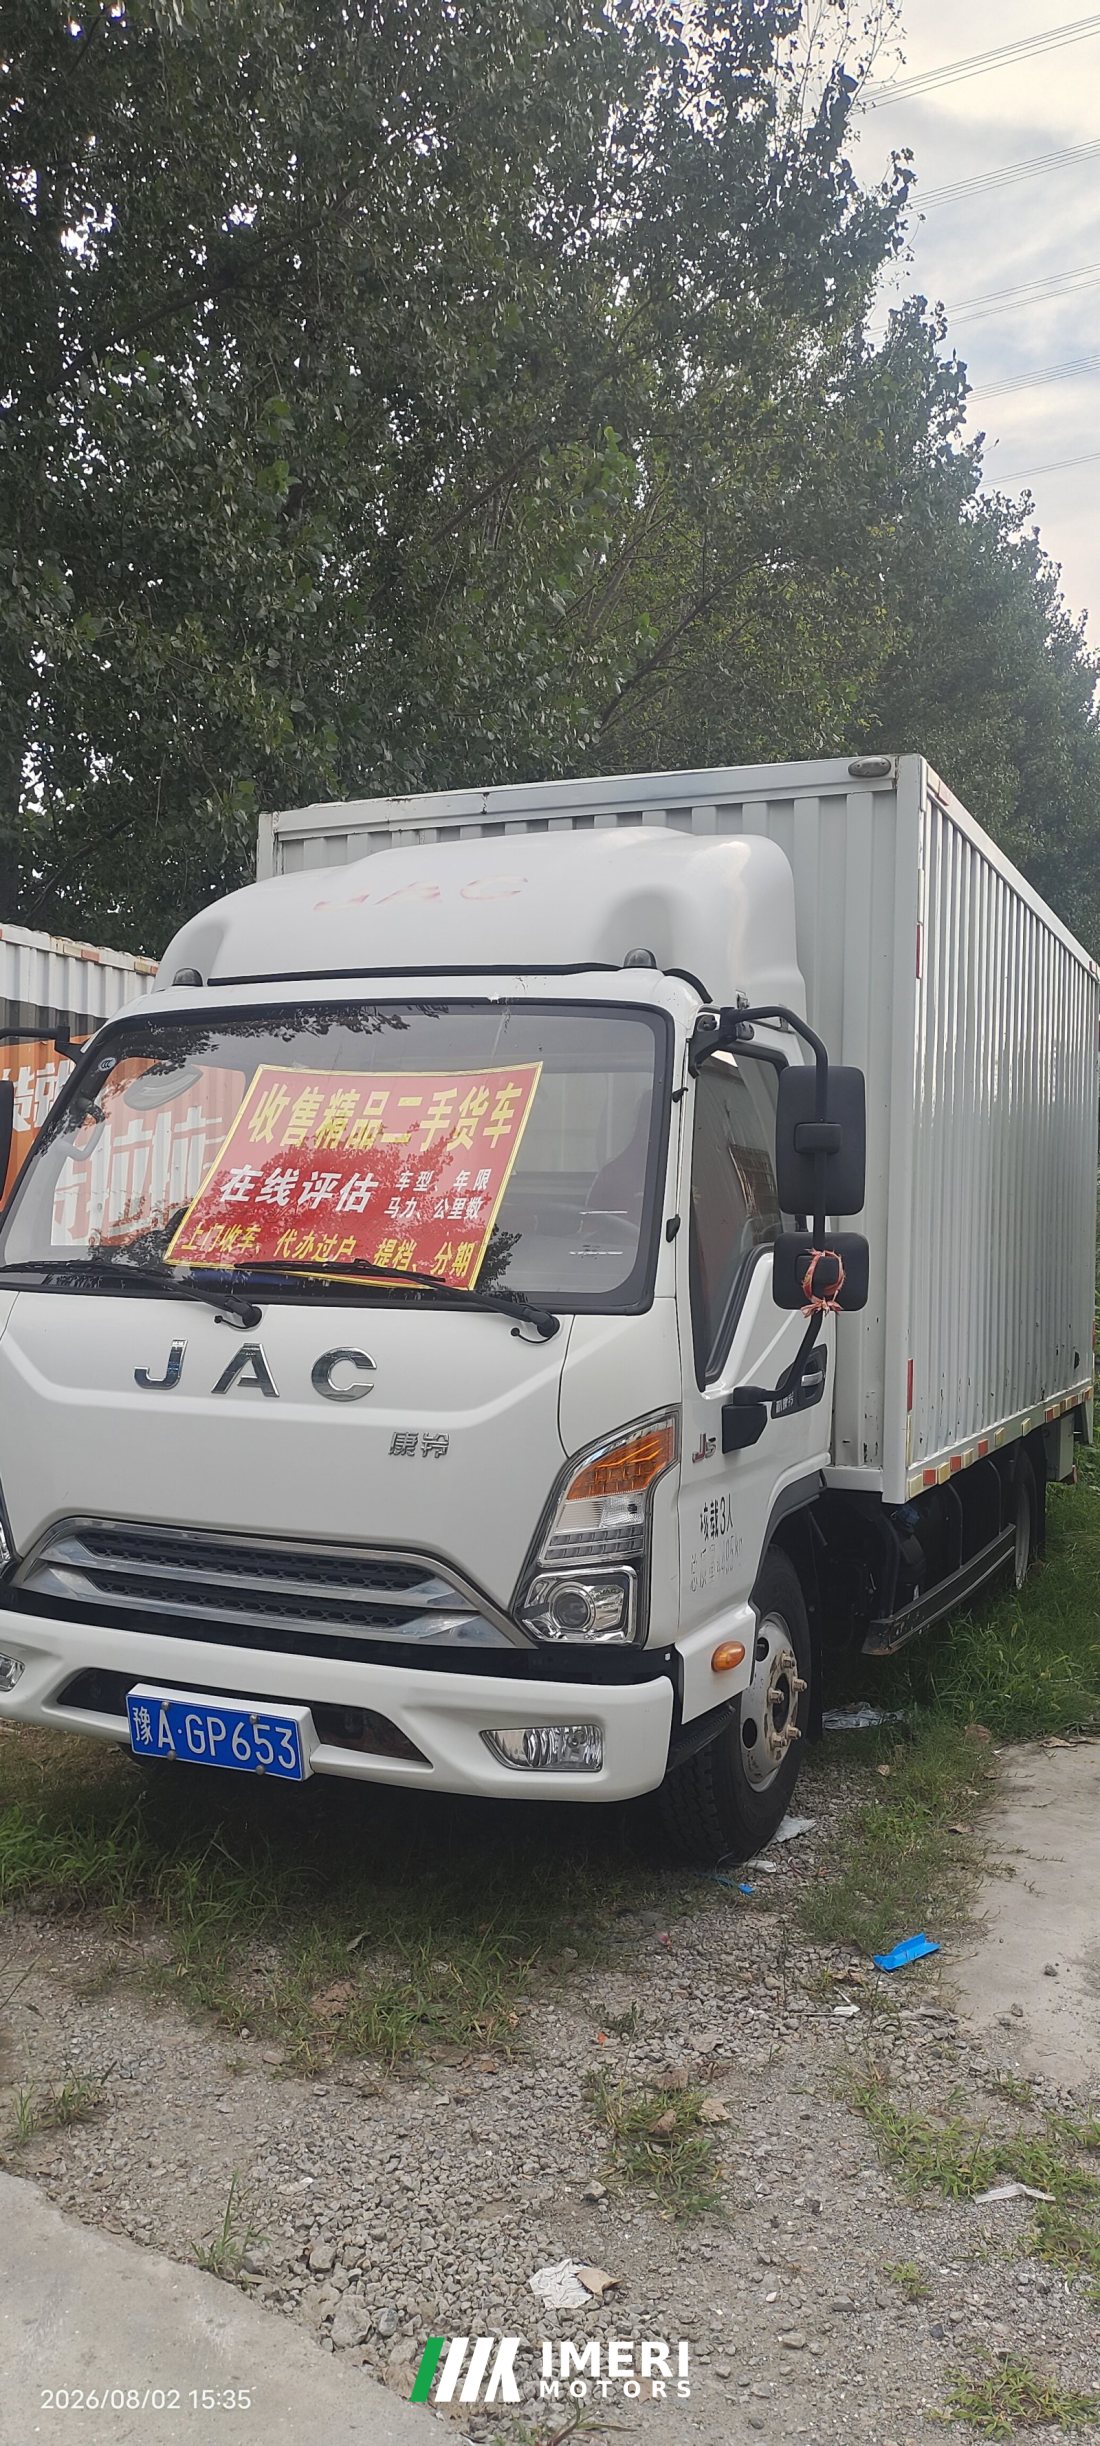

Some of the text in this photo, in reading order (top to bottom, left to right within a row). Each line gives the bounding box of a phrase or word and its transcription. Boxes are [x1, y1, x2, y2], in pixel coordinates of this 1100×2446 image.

[248, 1082, 523, 1152] 收售精品二手货车
[219, 1164, 380, 1213] 在线评估
[134, 1339, 378, 1402] JAC
[388, 1431, 450, 1459] 康铃
